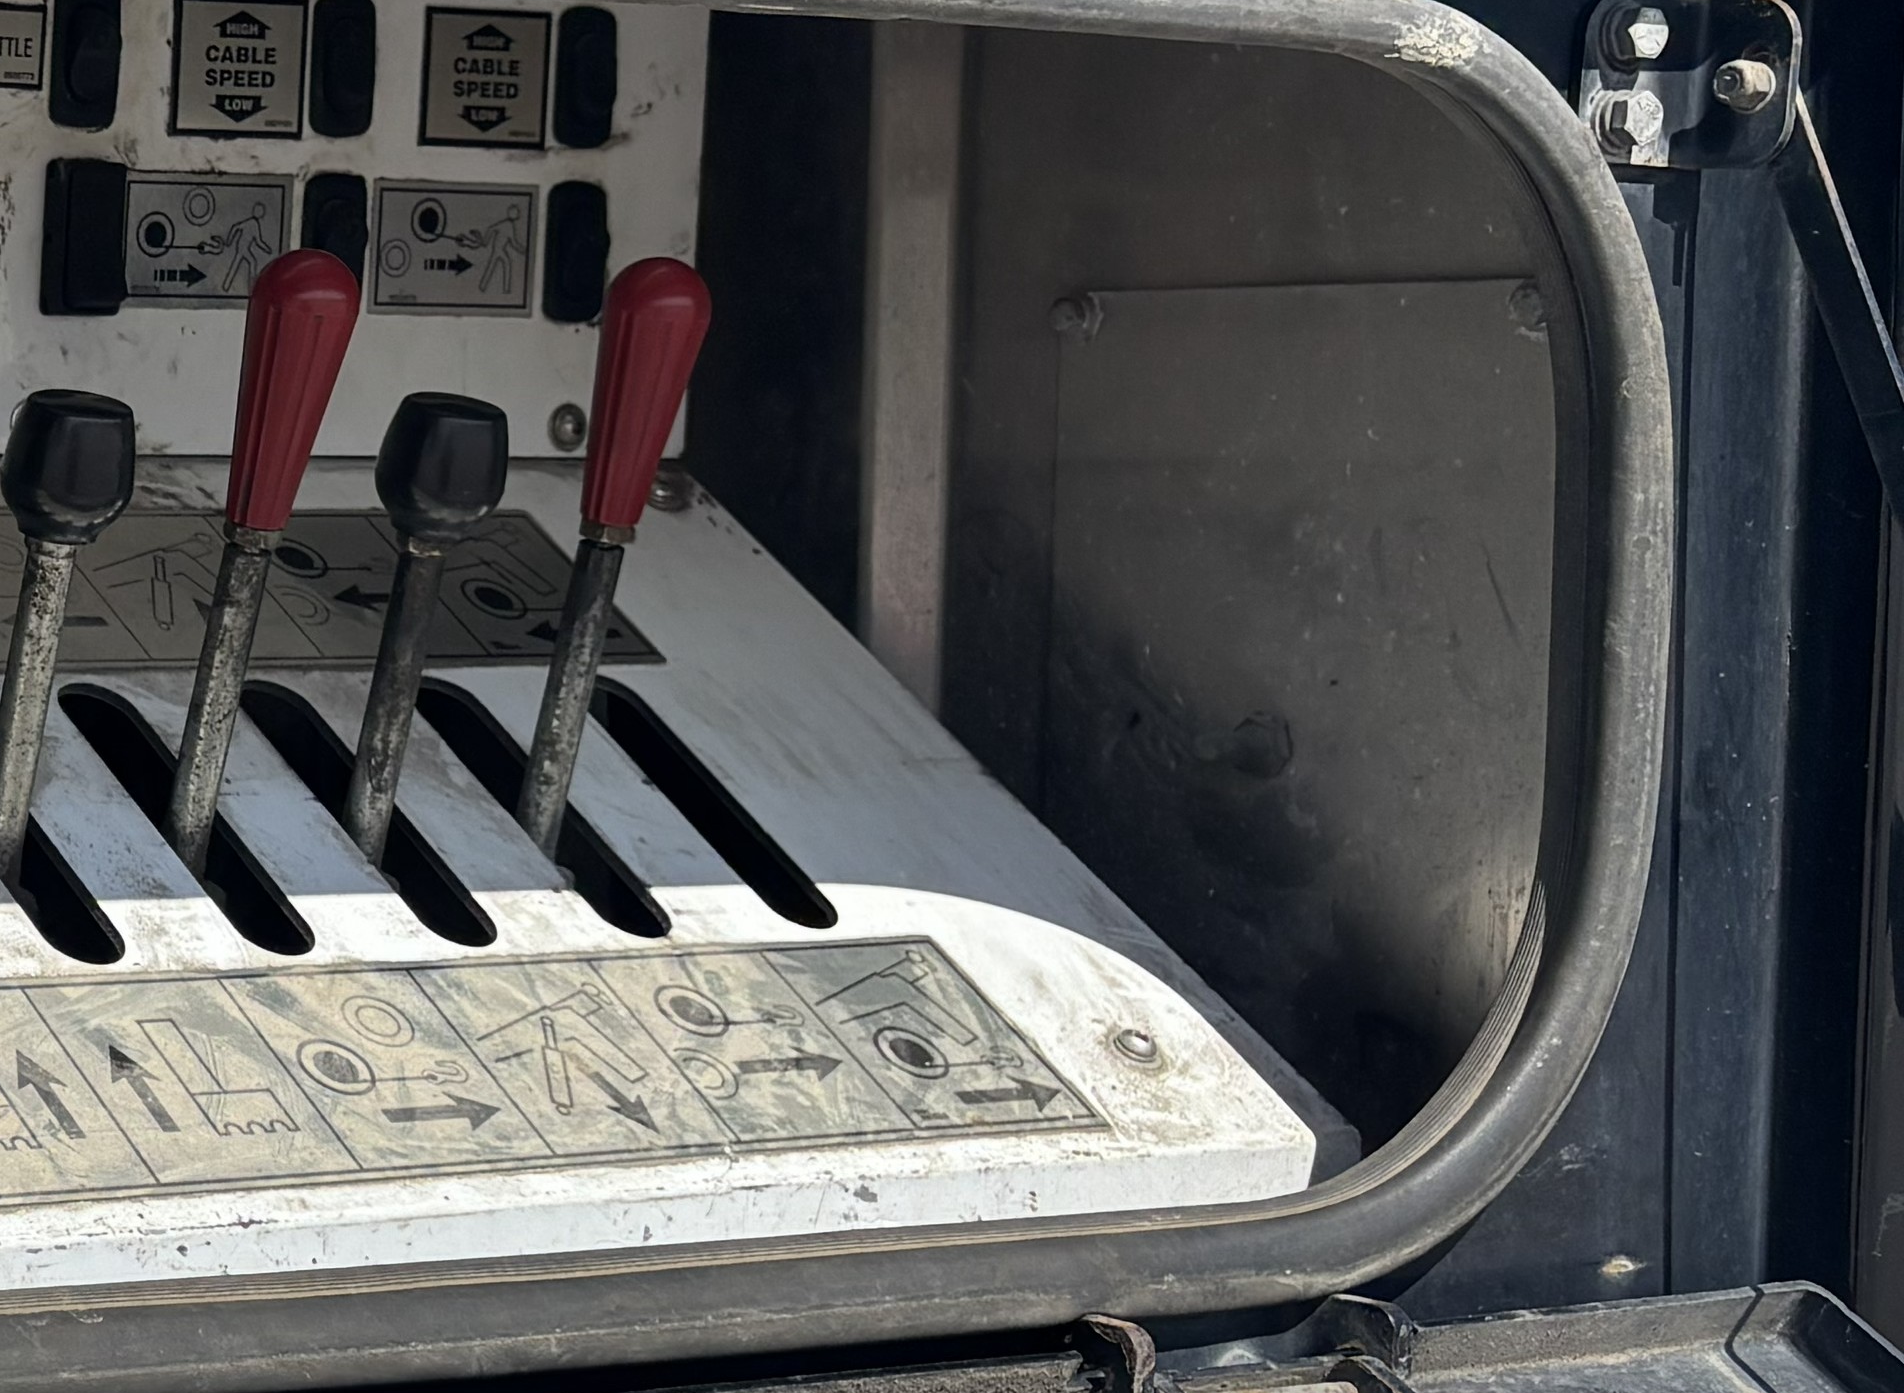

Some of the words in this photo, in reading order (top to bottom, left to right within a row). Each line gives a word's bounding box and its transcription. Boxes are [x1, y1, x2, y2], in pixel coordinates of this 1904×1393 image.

[225, 22, 259, 35] HIGH
[205, 45, 277, 65] CABLE
[453, 57, 520, 76] CABLE
[205, 68, 275, 88] SPEED
[453, 80, 519, 99] SPEED
[224, 98, 254, 111] LOW
